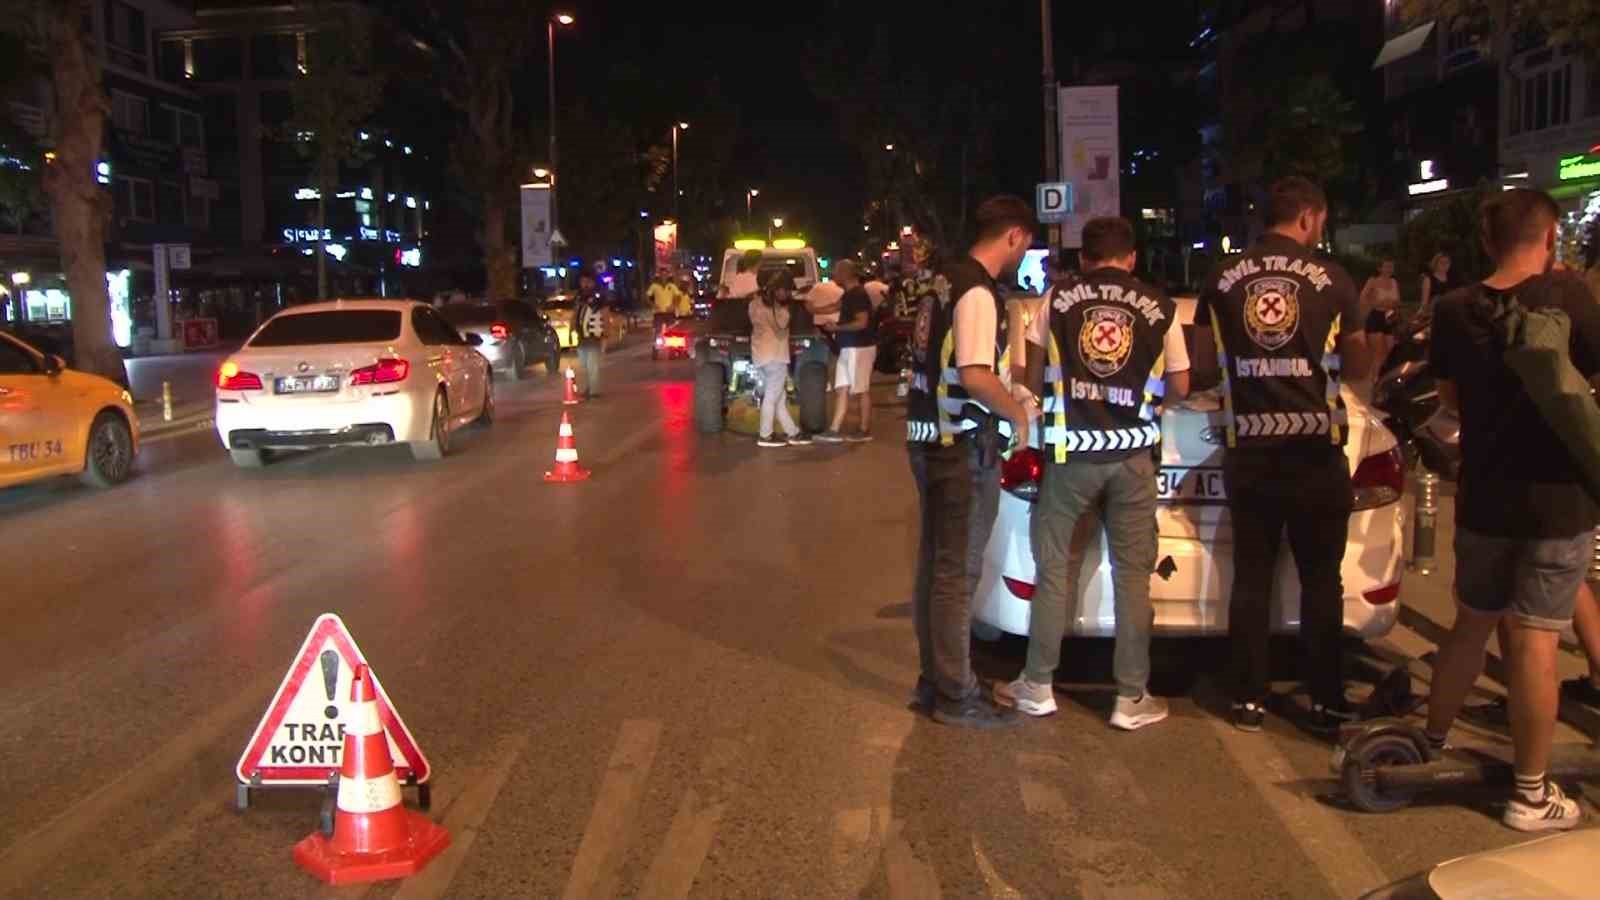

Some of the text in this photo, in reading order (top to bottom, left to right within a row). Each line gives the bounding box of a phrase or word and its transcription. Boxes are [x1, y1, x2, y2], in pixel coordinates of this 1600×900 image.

[1044, 188, 1062, 210] D
[1262, 256, 1333, 292] TRAFİK
[1053, 284, 1098, 313] SİVİL
[1098, 285, 1165, 327] TRAFİK
[1235, 356, 1312, 377] İSTANBUL
[45, 439, 63, 457] 34
[1157, 472, 1183, 496] 34
[284, 723, 347, 741] TRAF
[271, 745, 342, 763] KONT
